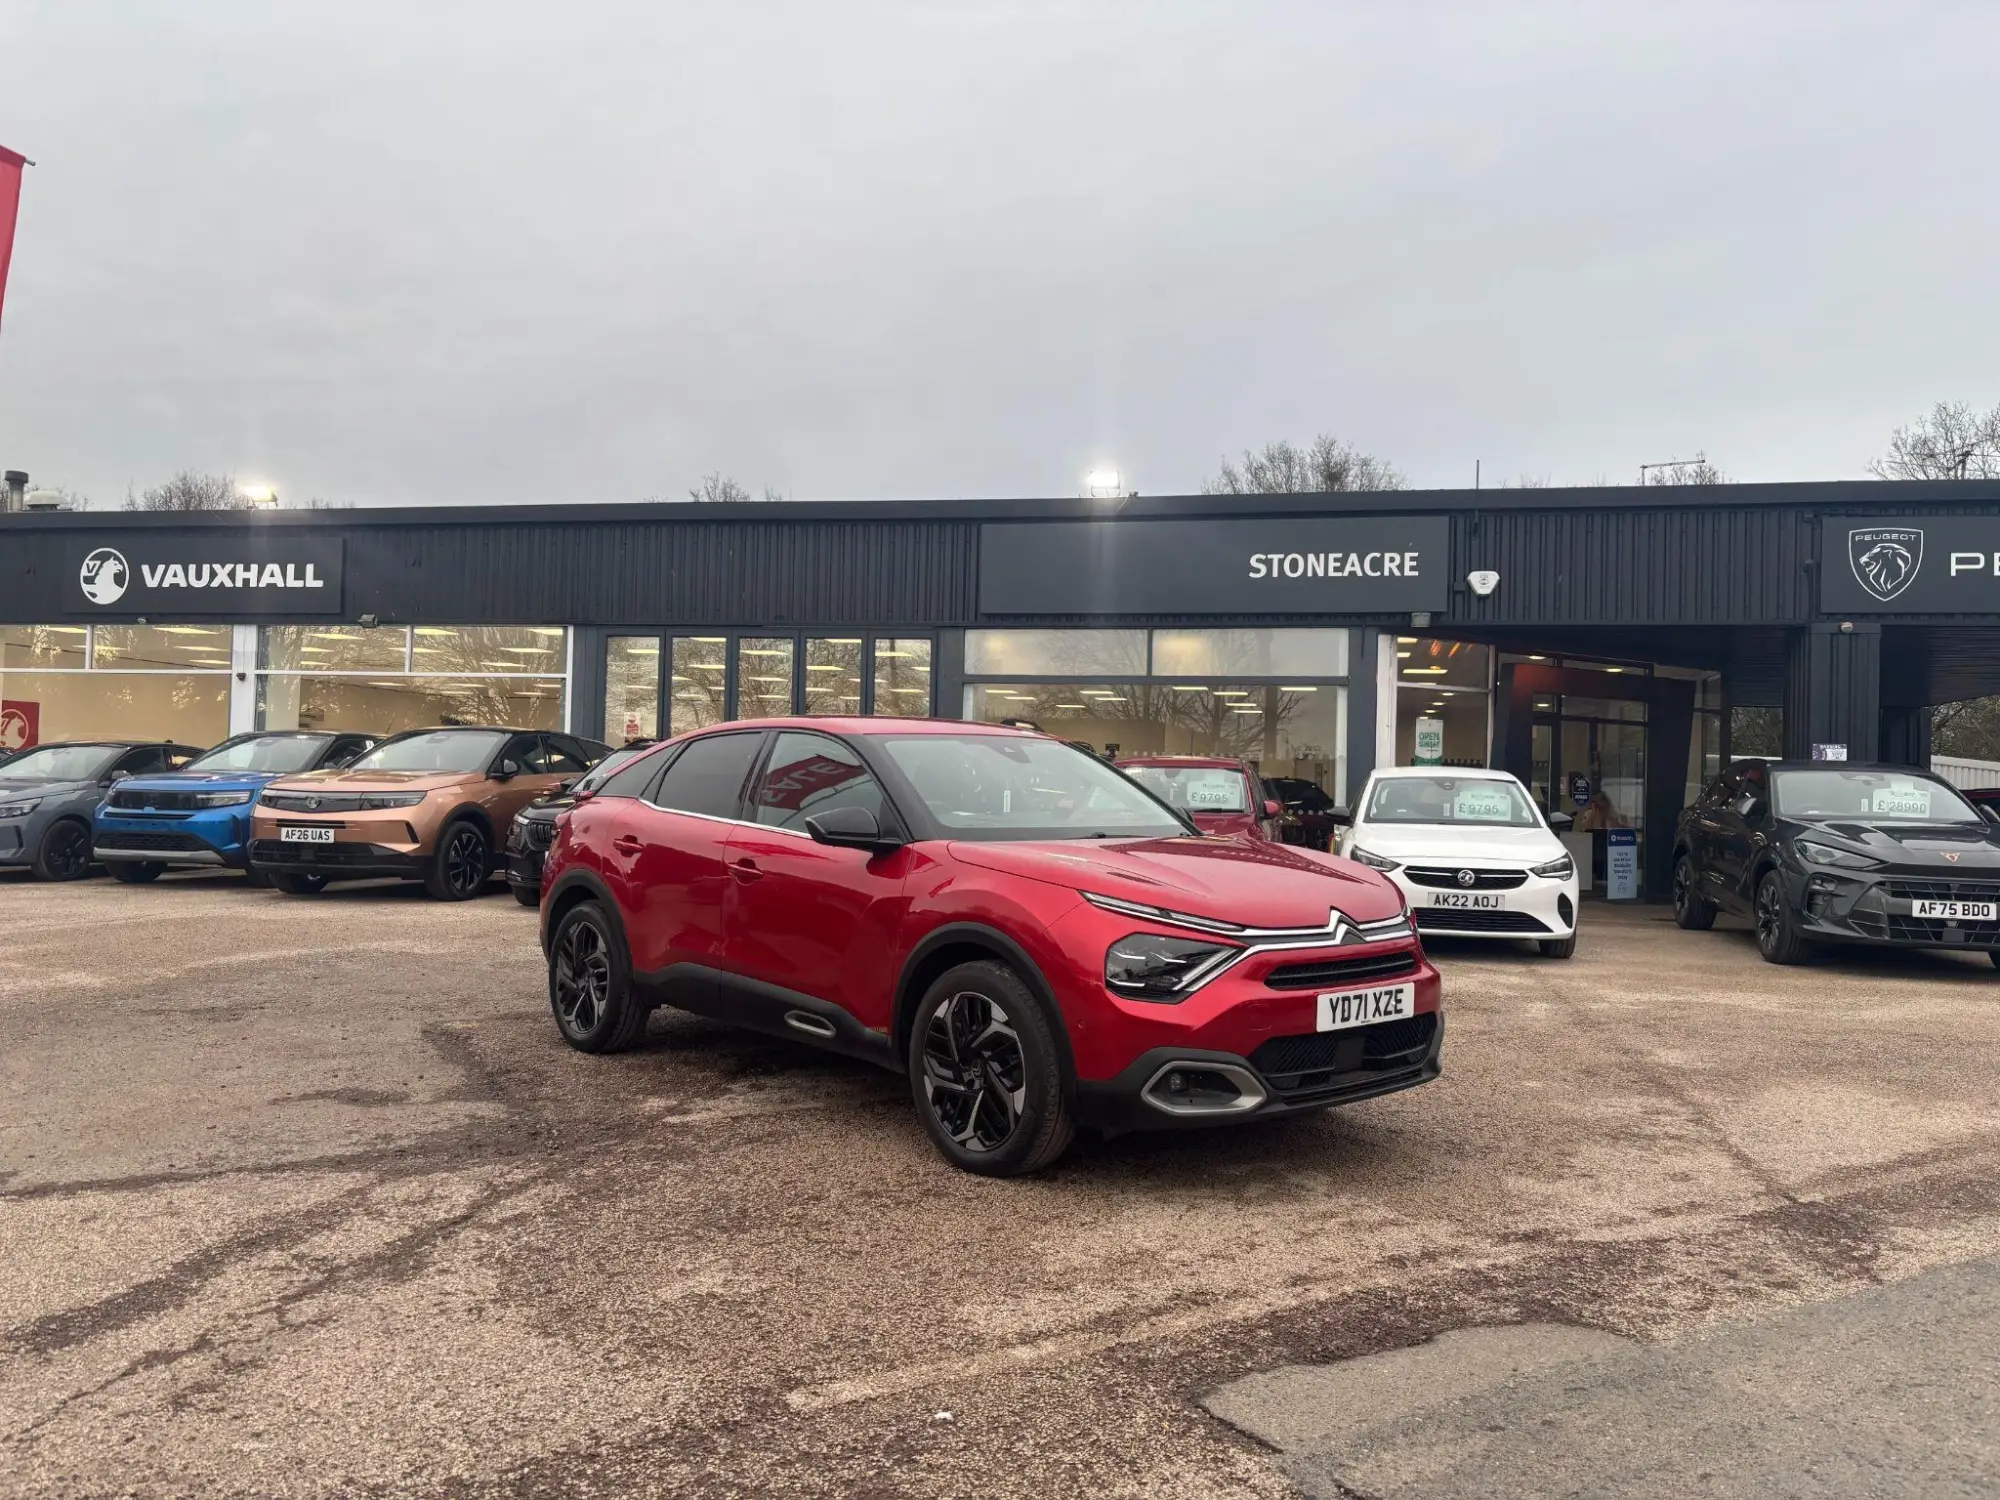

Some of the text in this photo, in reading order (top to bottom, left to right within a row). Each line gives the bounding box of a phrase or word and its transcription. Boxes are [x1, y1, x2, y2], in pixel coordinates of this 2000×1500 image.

[1855, 533, 1917, 542] PEUGEOT
[1249, 552, 1419, 578] STONEACRE
[141, 563, 324, 588] VAUXHALL
[1418, 732, 1440, 741] OPEN
[285, 829, 330, 841] AF26 UAS
[1434, 894, 1499, 908] AK22 AOJ
[1919, 902, 1990, 917] AF75 BDO
[1329, 988, 1404, 1025] YD71 XZE
